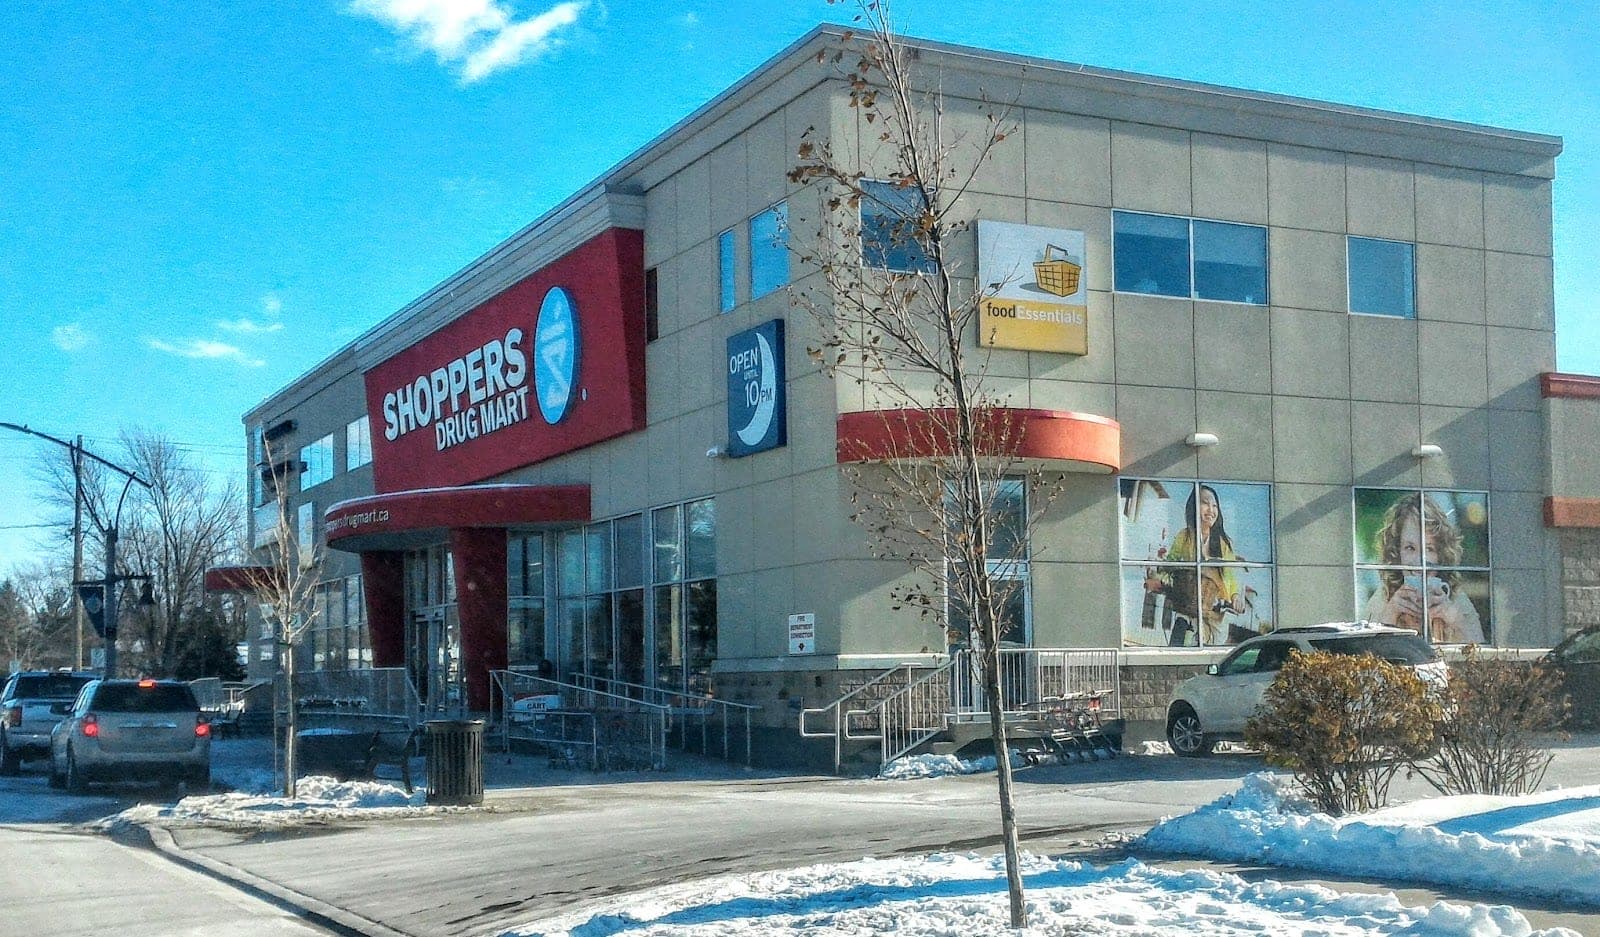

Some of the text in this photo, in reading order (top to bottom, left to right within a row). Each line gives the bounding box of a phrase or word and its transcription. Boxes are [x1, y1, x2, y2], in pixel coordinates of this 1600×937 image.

[729, 347, 758, 374] OPEN
[383, 327, 526, 441] SHOPPERS
[744, 380, 773, 408] 10 PM
[434, 386, 529, 451] DRUG MART
[526, 702, 546, 710] CART
